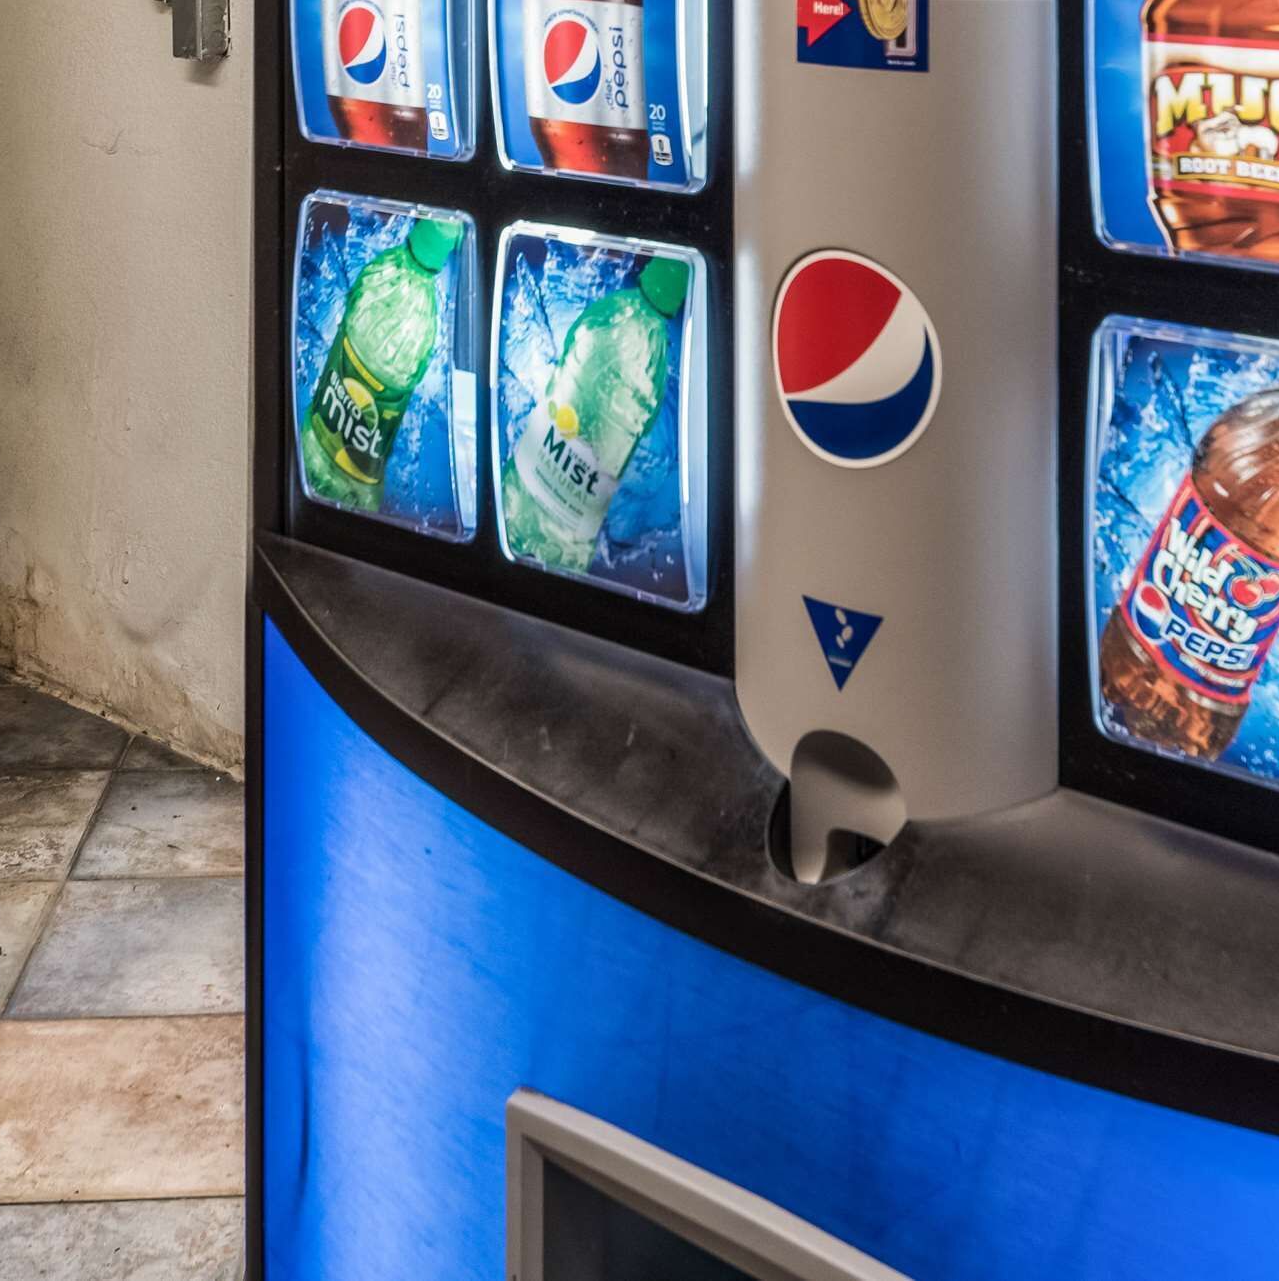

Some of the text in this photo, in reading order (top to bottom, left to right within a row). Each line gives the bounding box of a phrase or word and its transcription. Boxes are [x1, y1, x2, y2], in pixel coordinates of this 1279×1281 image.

[813, 1, 844, 16] Here!
[394, 14, 410, 88] pepsi
[610, 27, 629, 108] pepsi
[427, 83, 441, 100] 20
[605, 79, 613, 106] diet
[649, 104, 666, 121] 20
[1179, 157, 1231, 174] ROOT
[543, 425, 599, 496] Mist
[1168, 517, 1235, 594] Wild
[1152, 548, 1258, 643] Cherry
